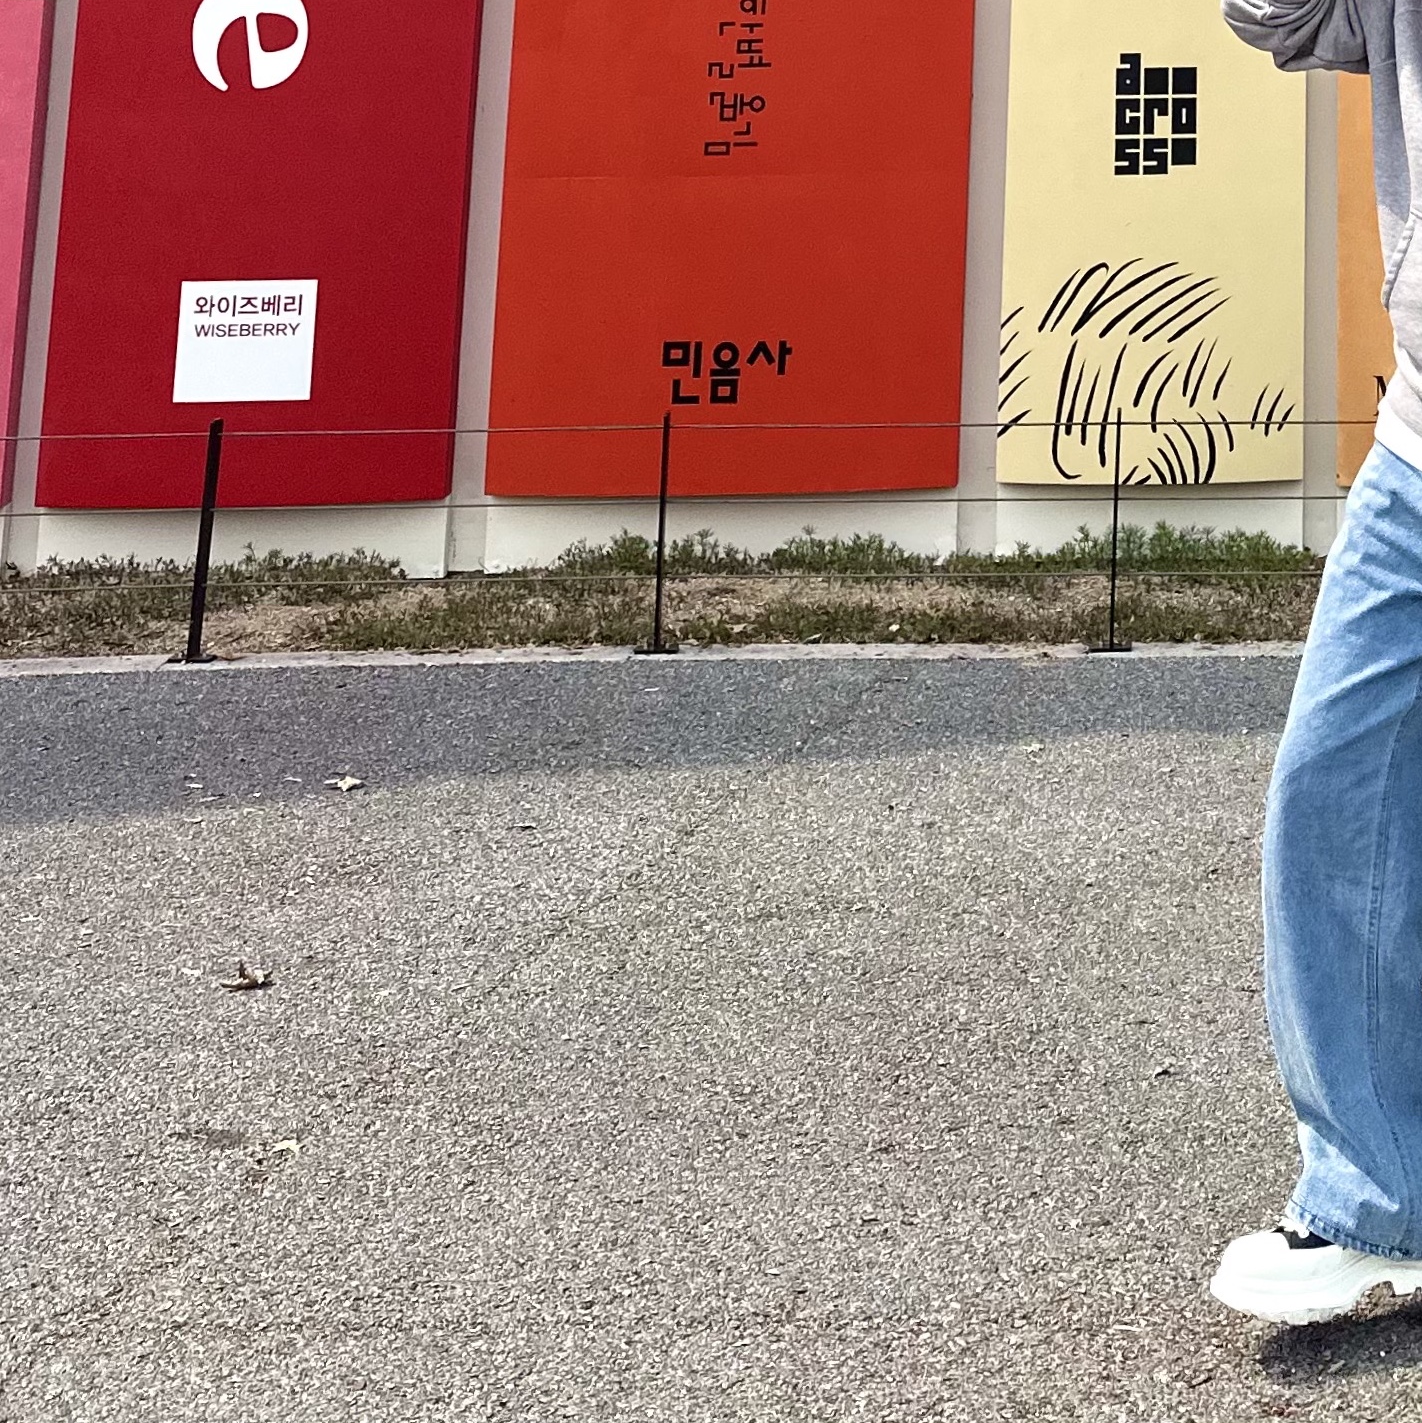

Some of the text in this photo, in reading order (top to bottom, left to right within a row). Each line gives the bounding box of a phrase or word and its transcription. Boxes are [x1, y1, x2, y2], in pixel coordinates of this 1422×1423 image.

[704, 91, 765, 156] 옮김
[194, 294, 302, 317] 와이즈베리
[195, 323, 300, 337] WISEBERRY
[662, 340, 792, 405] 민음사
